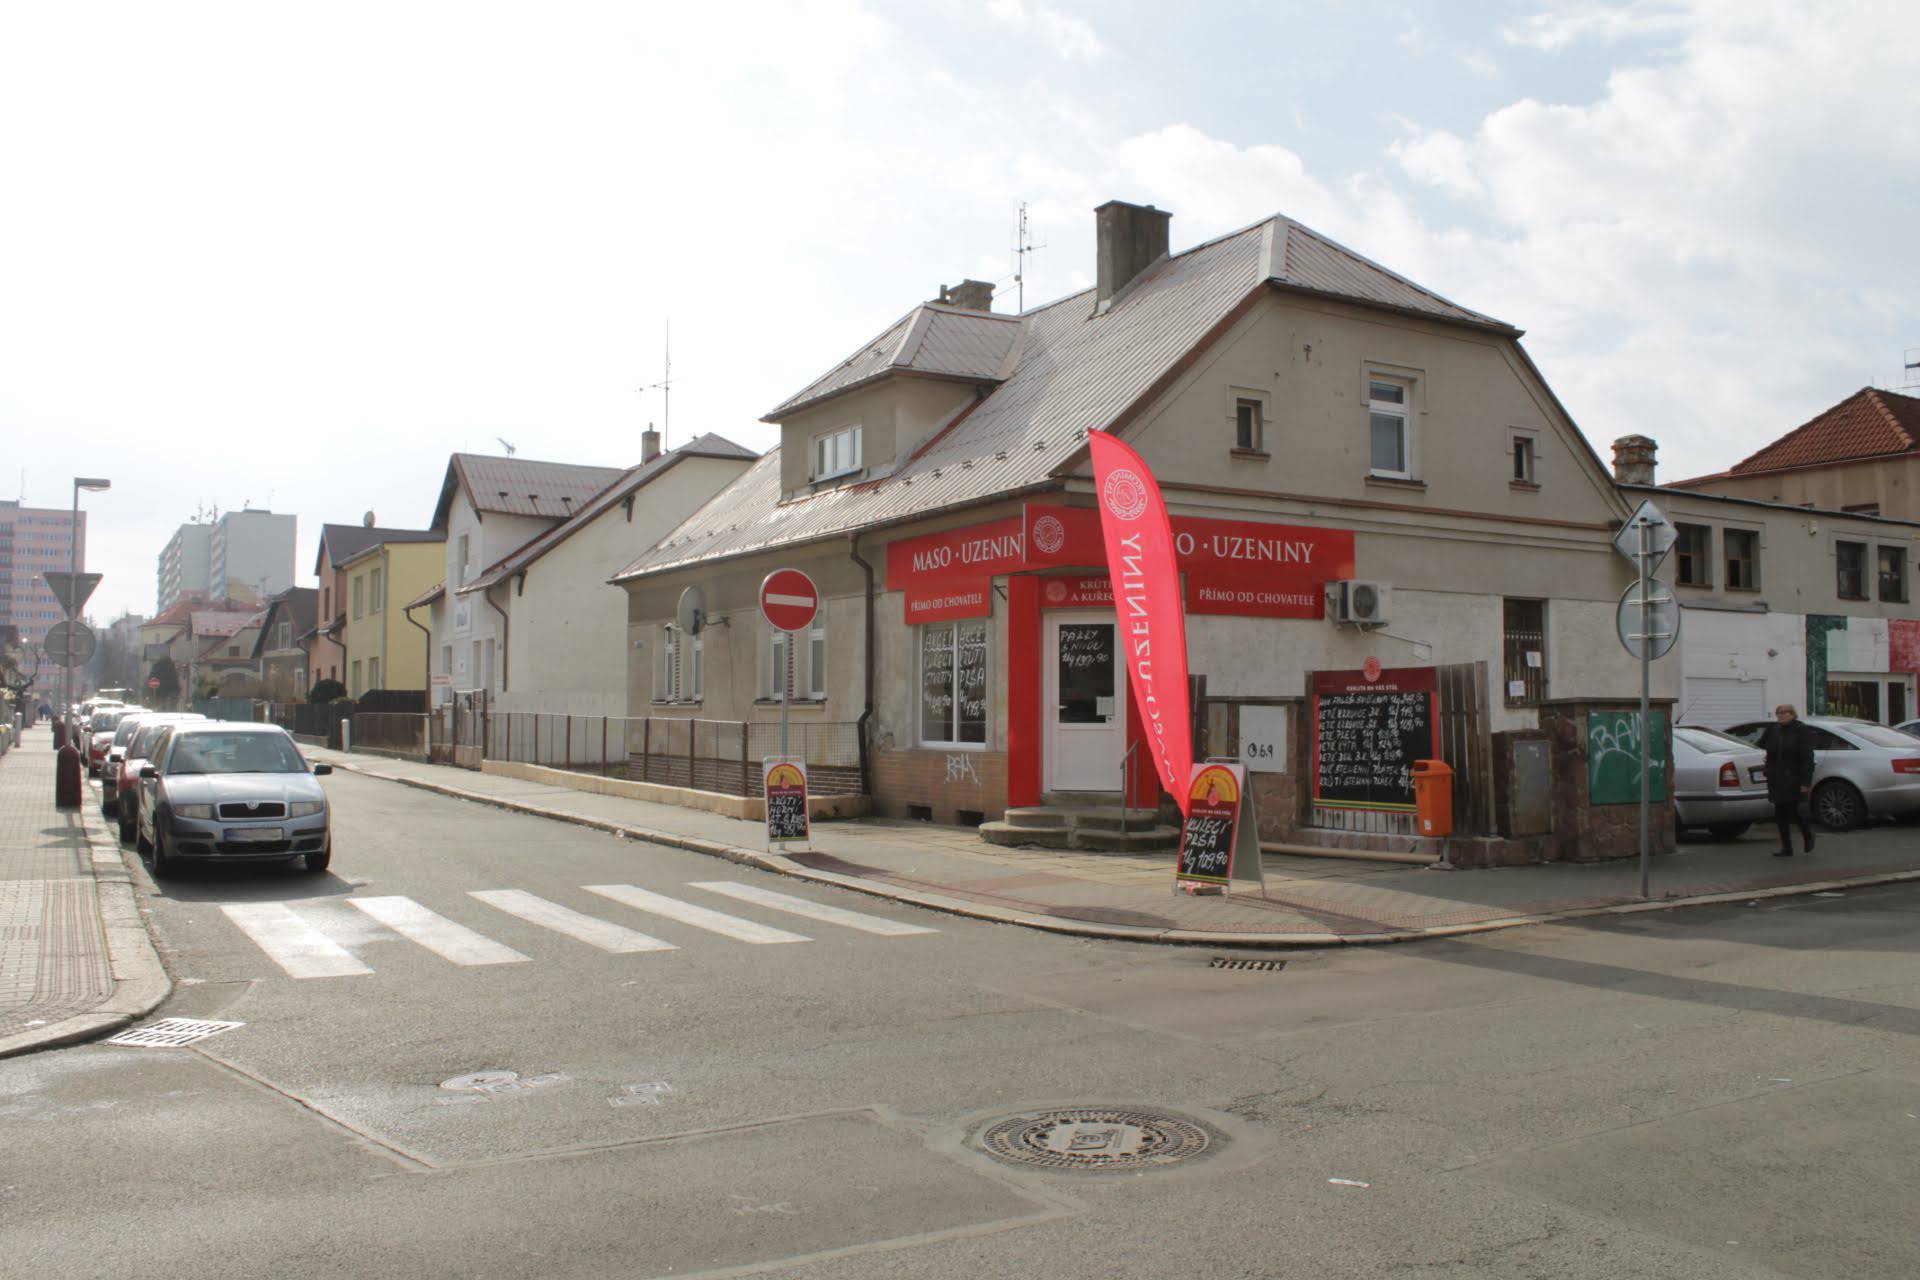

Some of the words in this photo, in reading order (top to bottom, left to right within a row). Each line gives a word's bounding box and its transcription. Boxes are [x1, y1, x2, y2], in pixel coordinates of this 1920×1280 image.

[912, 545, 952, 573] MASO
[961, 533, 1022, 564] UZENIN
[1213, 535, 1314, 563] UZENINY
[911, 598, 931, 612] PŘÍMO
[932, 598, 943, 609] OD
[944, 593, 982, 608] CHOVATELE
[1081, 591, 1115, 602] KUŘEC
[1199, 587, 1234, 602] PŘÍMO
[1237, 591, 1254, 603] OD
[1256, 592, 1314, 607] CHOVATELE
